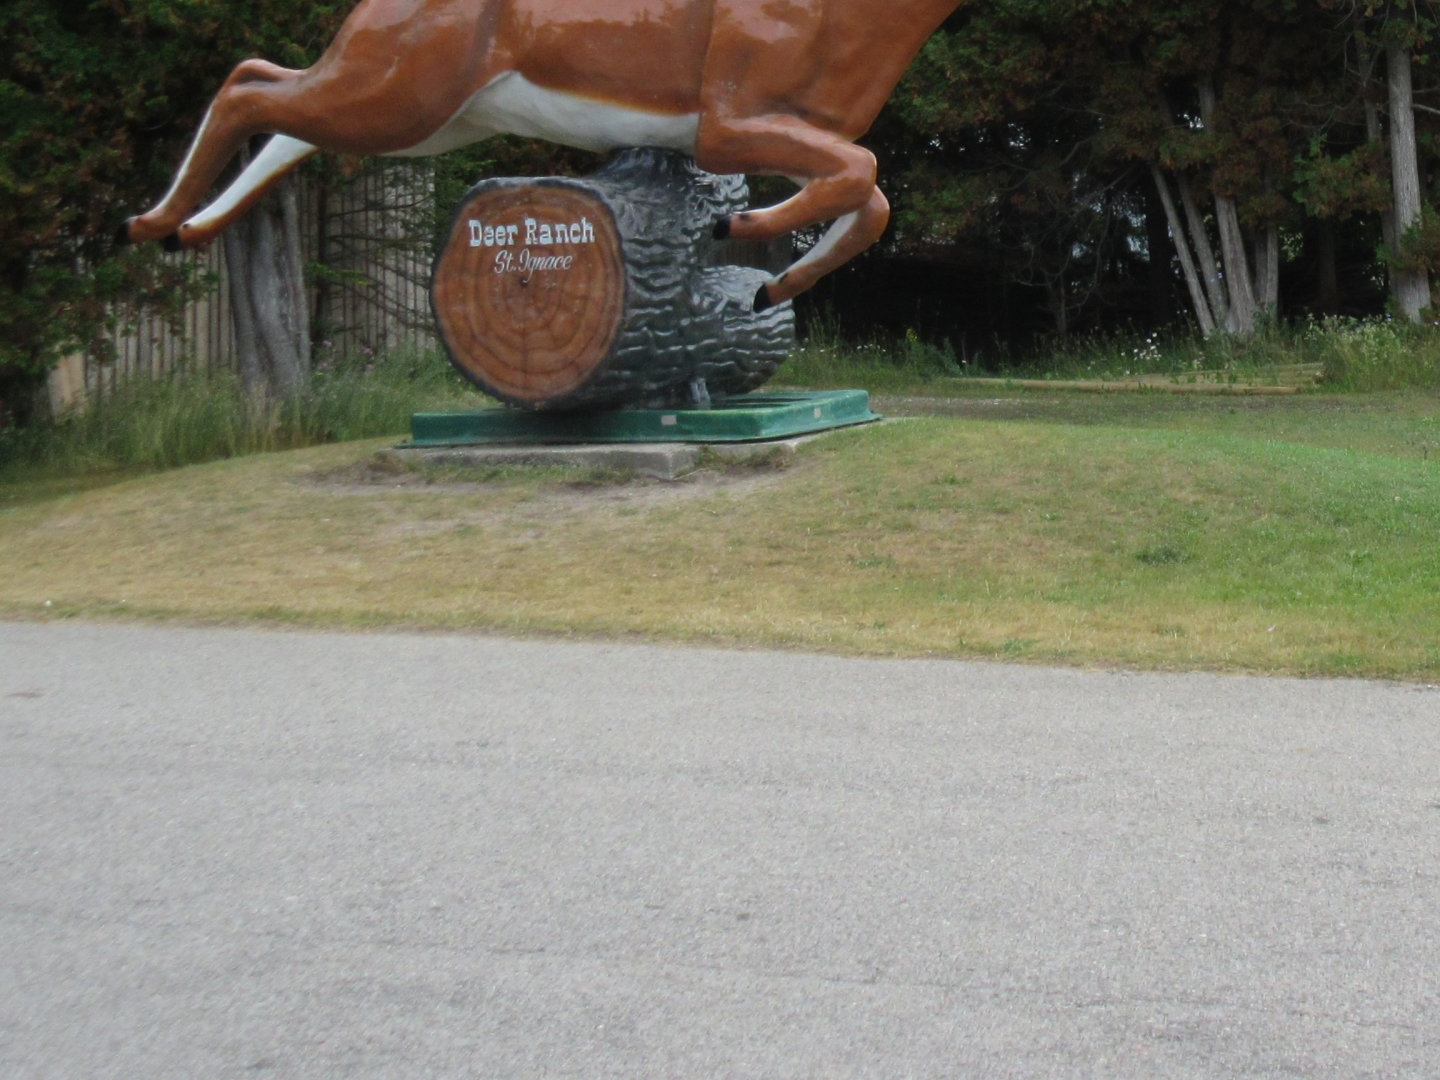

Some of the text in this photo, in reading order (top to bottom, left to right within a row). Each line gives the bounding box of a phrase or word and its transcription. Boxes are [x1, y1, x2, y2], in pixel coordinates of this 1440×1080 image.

[468, 216, 595, 247] Deer Ranch
[494, 248, 573, 283] St. Ignace
